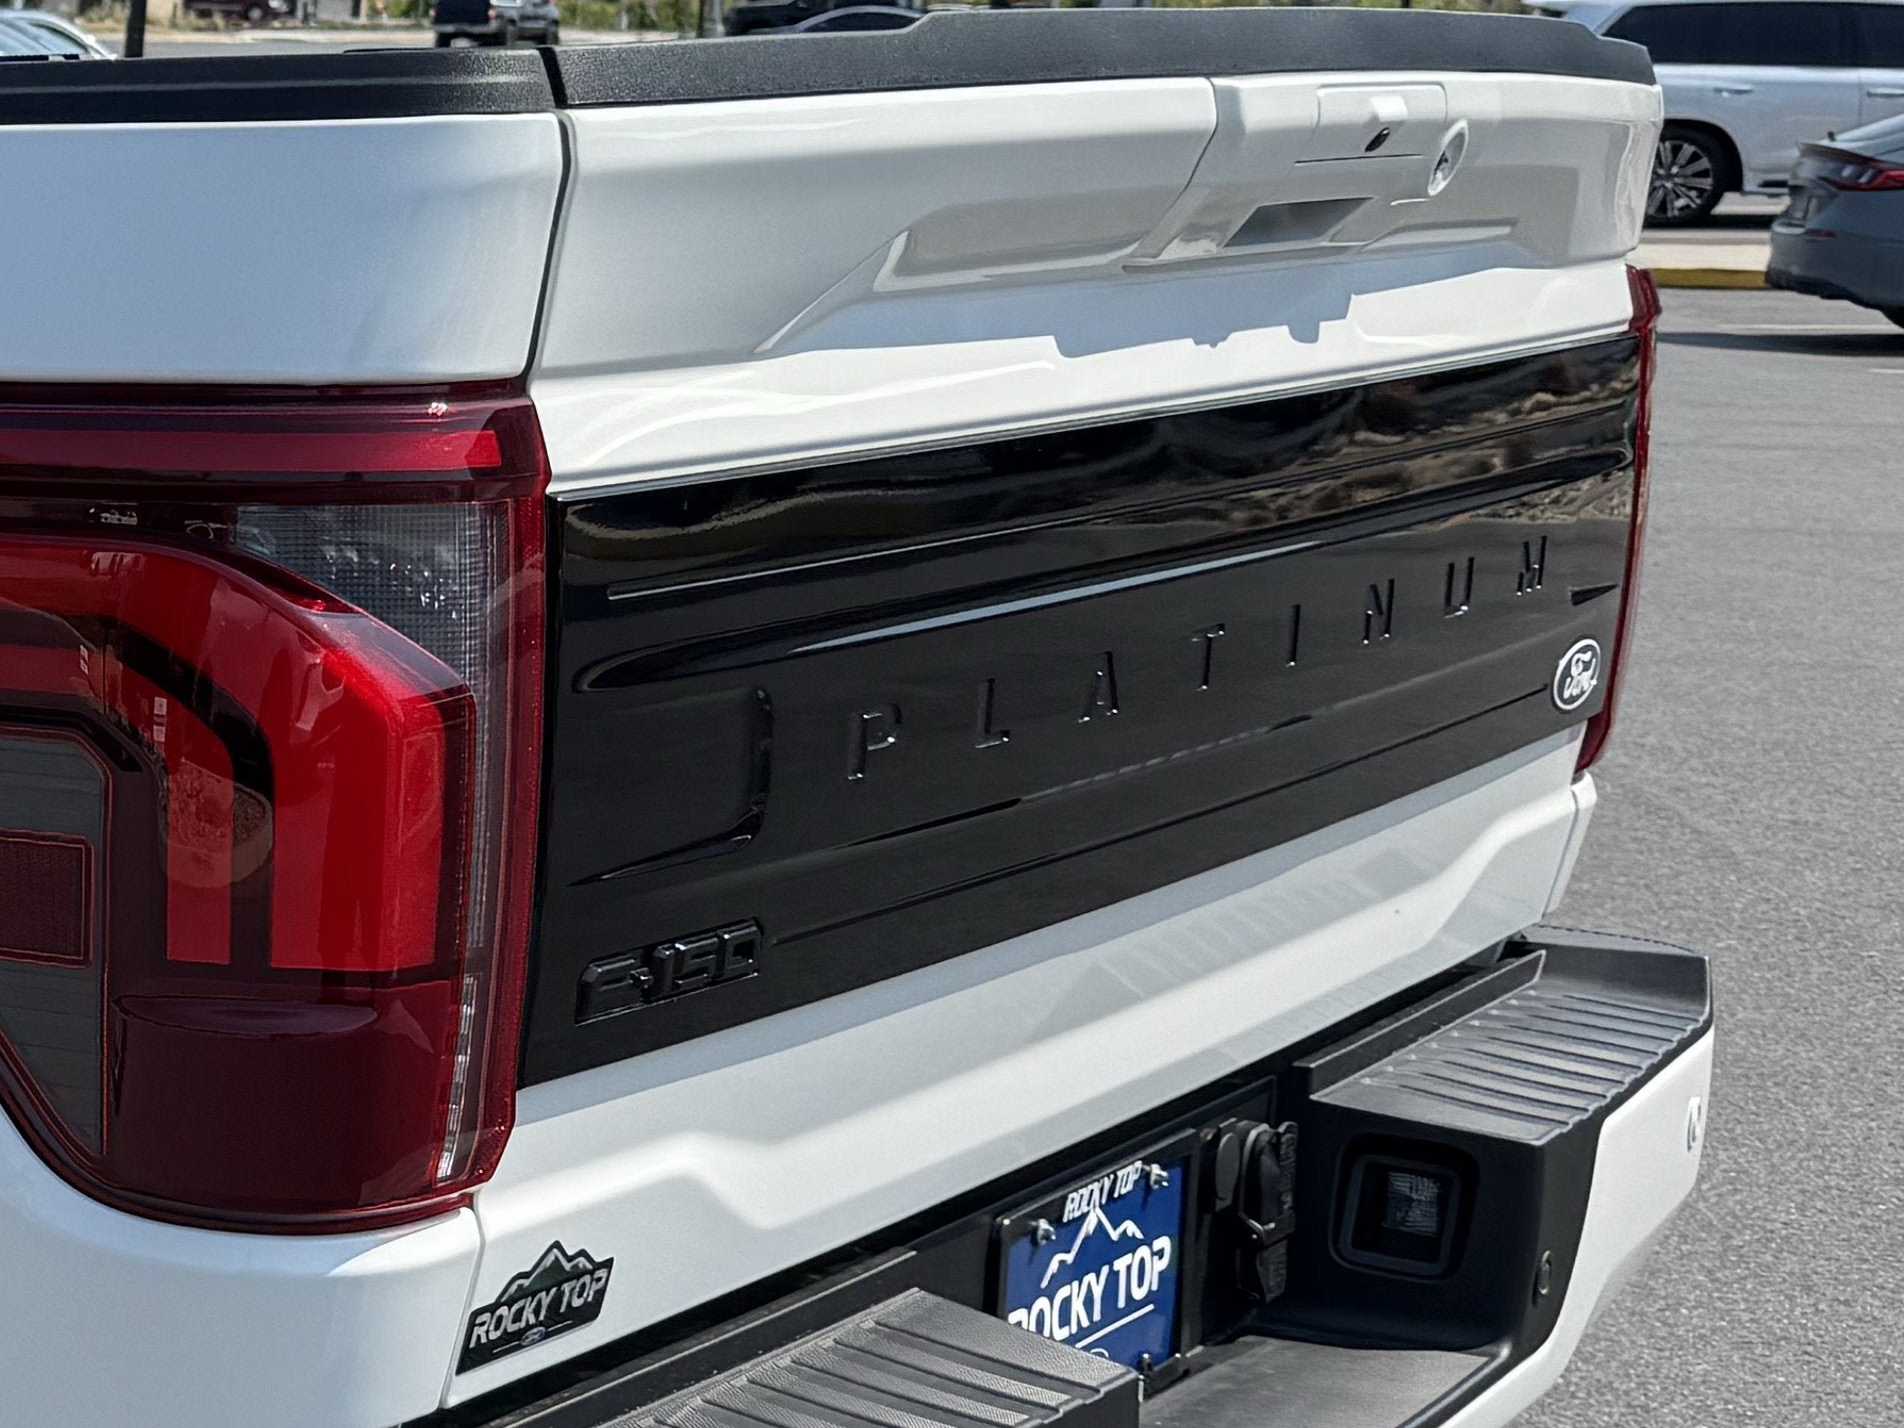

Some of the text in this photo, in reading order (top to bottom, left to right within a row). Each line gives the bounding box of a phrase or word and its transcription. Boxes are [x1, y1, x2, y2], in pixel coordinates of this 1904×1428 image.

[847, 535, 1548, 780] PLATINUM
[1563, 650, 1597, 700] Ford
[575, 916, 766, 1027] F-150
[1063, 1160, 1143, 1222] ROCKY TOP
[469, 1268, 609, 1349] ROCKY TOP
[1113, 1235, 1172, 1309] TOP
